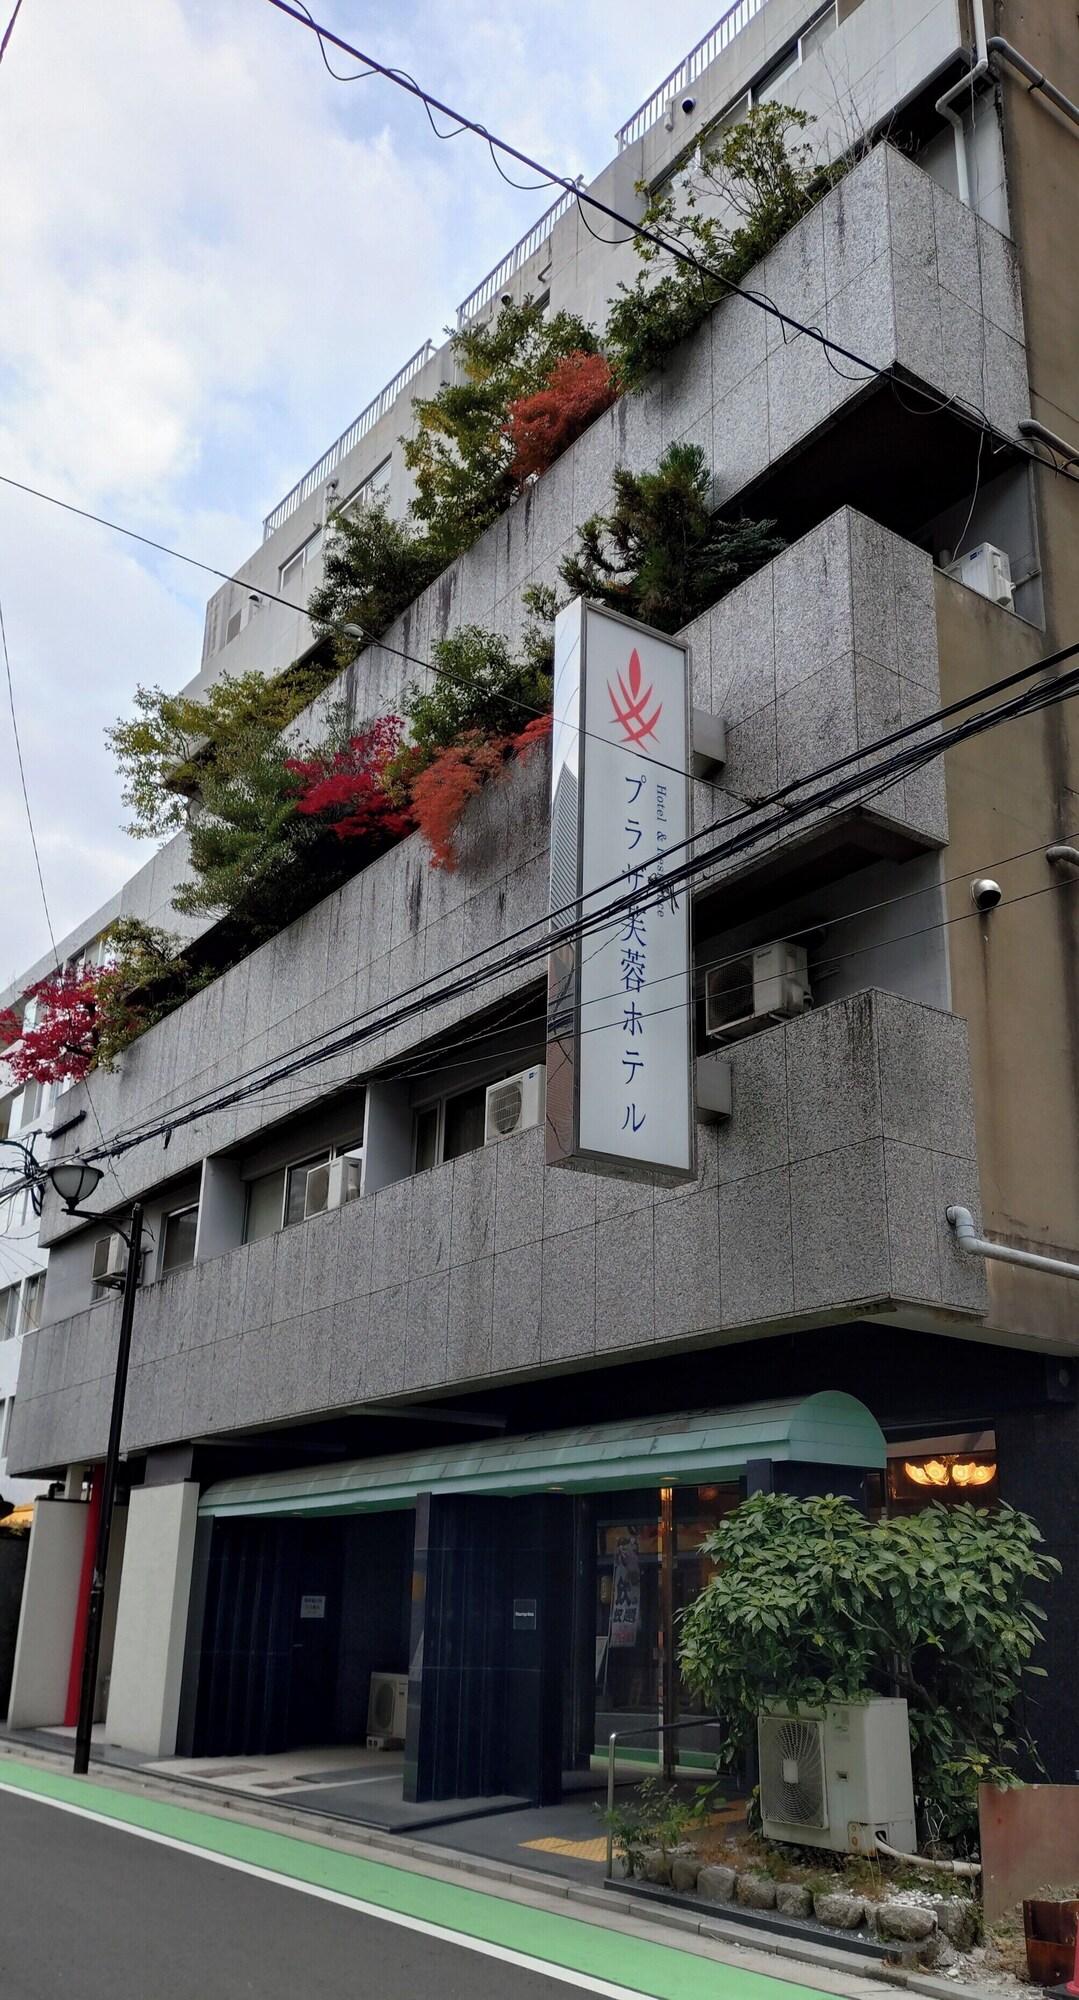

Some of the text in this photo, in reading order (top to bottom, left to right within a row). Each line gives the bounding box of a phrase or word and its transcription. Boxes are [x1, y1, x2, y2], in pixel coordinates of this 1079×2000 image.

[655, 783, 668, 823] Hotel
[655, 830, 668, 844] &
[621, 773, 647, 1133] プラザ芙蓉ホテル
